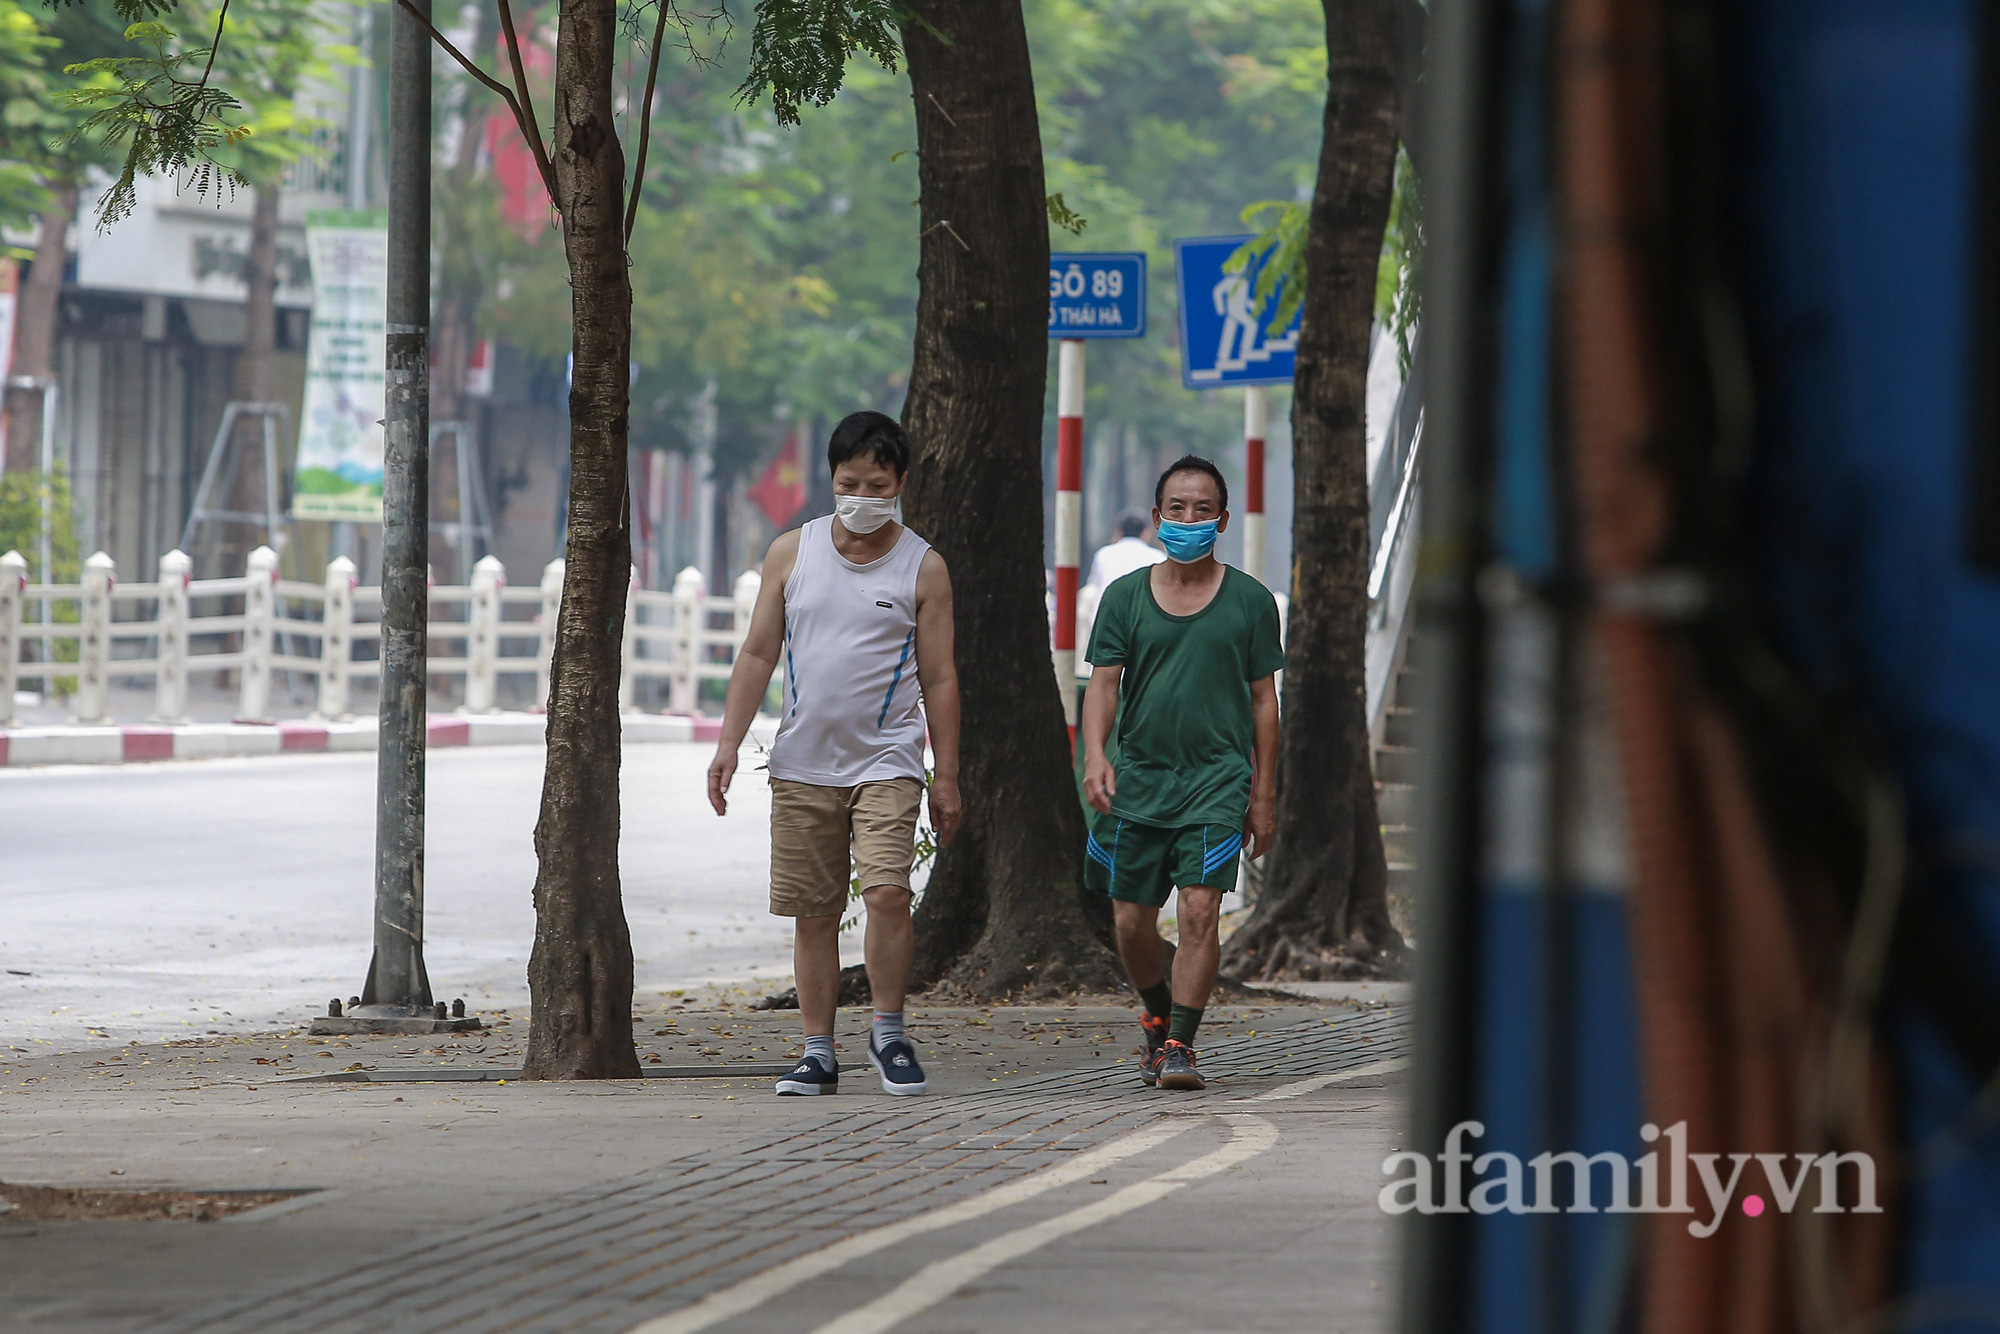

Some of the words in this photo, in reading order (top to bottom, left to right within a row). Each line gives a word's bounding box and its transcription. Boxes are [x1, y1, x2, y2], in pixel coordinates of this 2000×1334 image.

[1050, 263, 1085, 298] GÕ
[1092, 269, 1123, 298] 89
[1060, 302, 1097, 325] THÁI
[1098, 302, 1123, 325] HÀ
